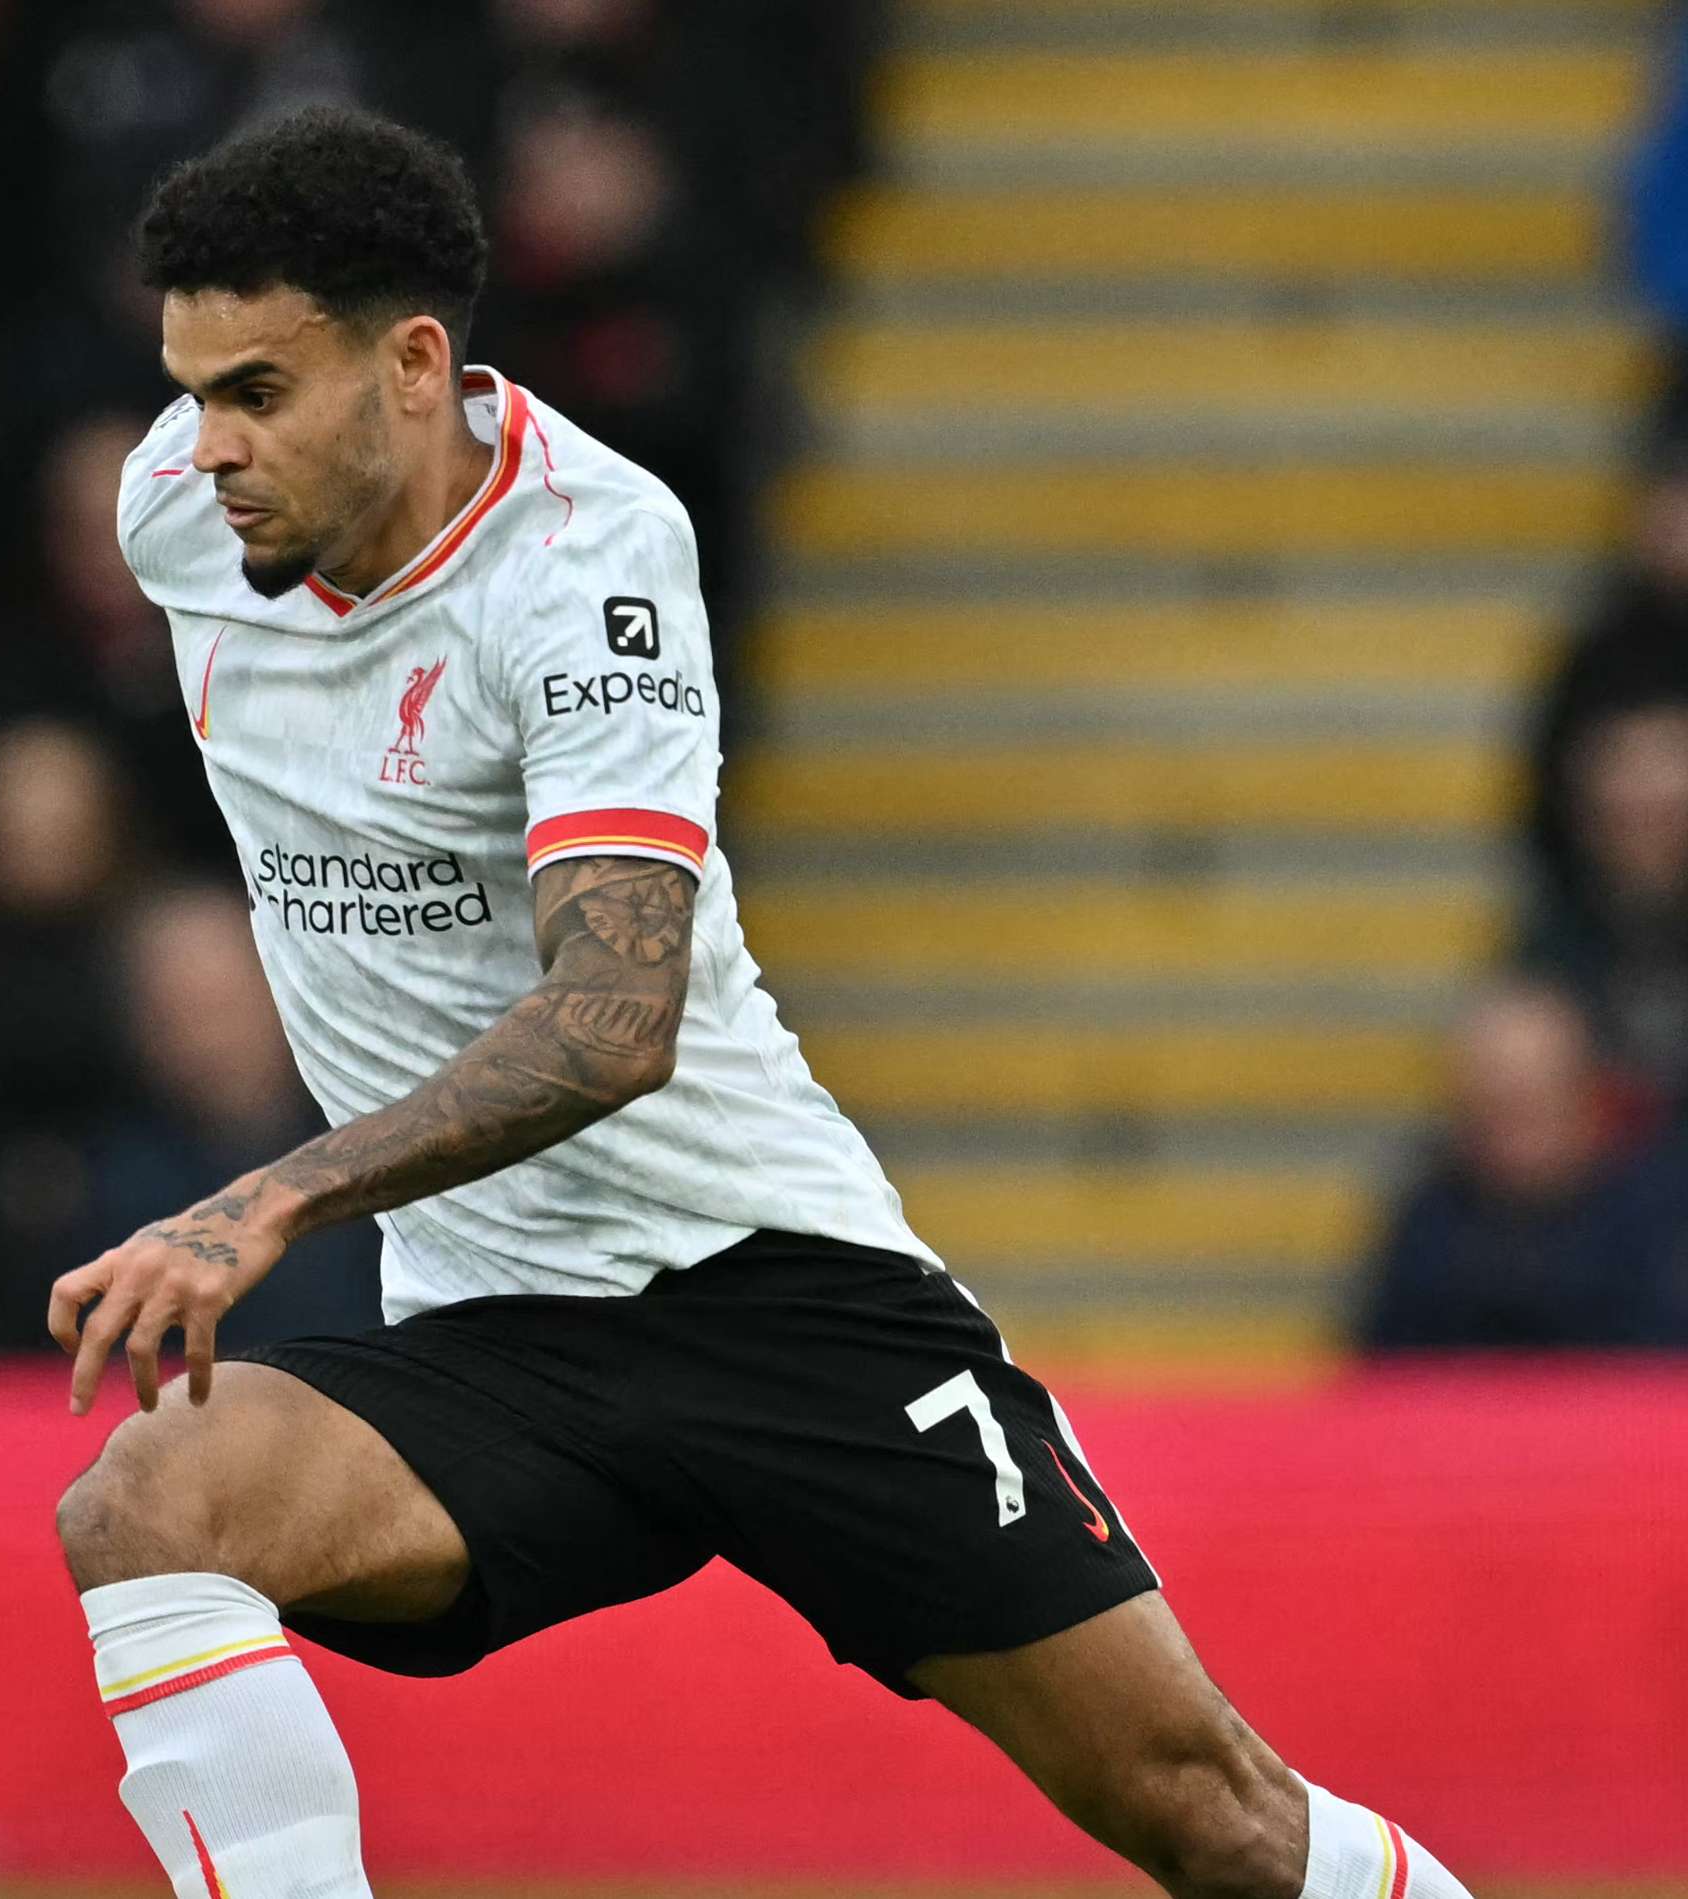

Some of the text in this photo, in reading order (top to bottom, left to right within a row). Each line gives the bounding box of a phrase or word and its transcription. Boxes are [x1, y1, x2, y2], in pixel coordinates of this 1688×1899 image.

[542, 669, 706, 718] Expedia
[258, 843, 465, 894] standard
[903, 1368, 1027, 1528] 7
